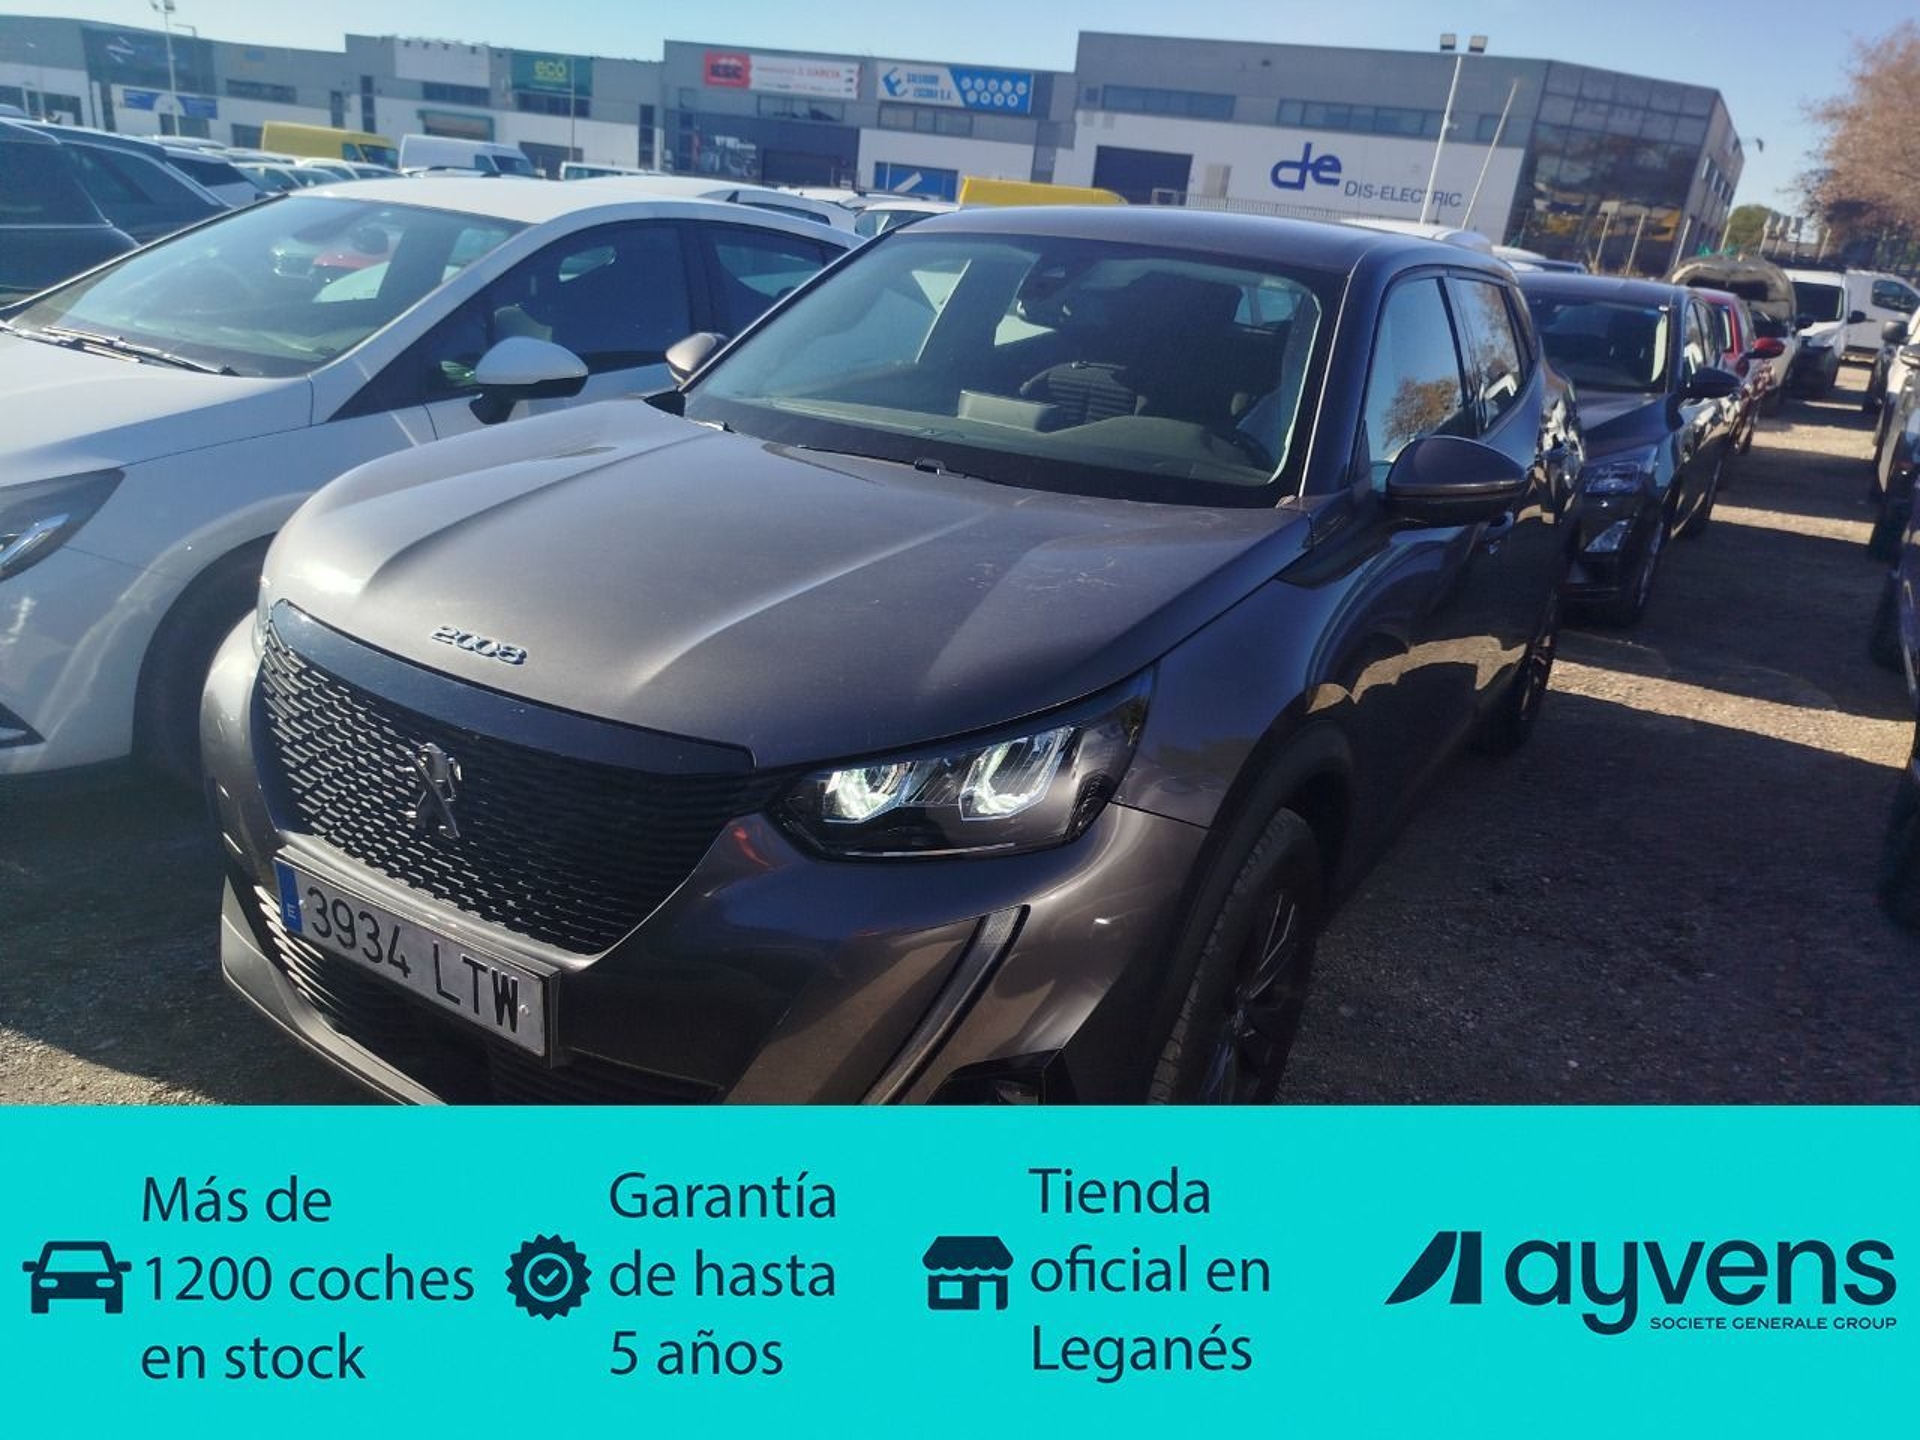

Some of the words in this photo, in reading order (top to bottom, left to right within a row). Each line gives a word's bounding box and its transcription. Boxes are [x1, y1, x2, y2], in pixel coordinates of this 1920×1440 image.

[1344, 180, 1463, 208] DIS-ELECRIC
[431, 624, 528, 666] 2008
[307, 886, 412, 979] 3934
[432, 940, 520, 1035] LTW
